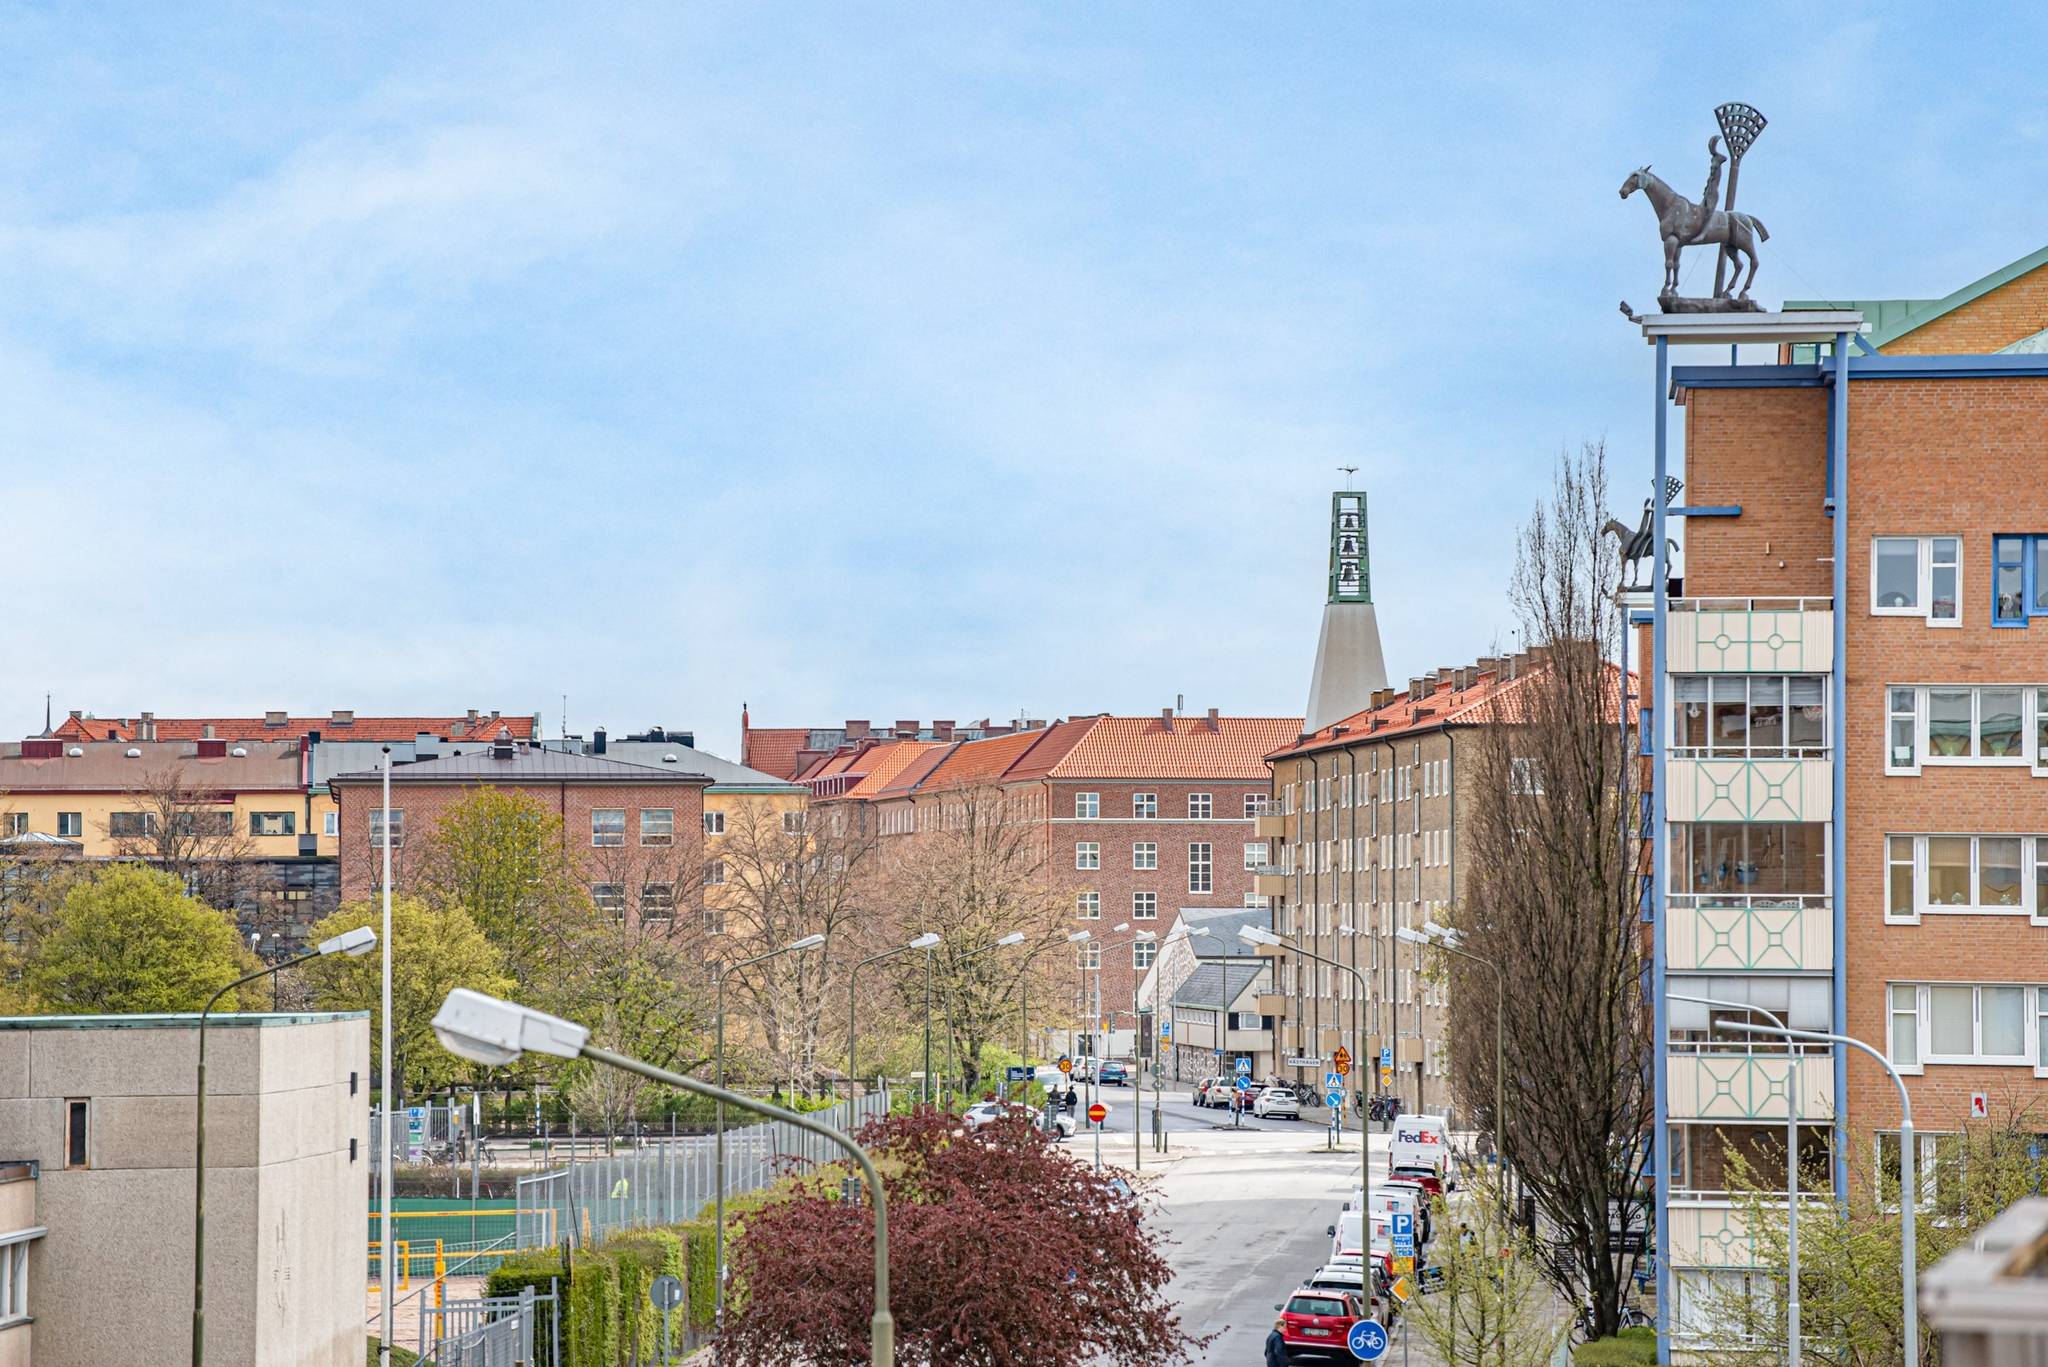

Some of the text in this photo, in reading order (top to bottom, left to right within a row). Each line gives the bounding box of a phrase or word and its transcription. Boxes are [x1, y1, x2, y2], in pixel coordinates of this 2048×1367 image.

[1337, 1065, 1347, 1073] 30
[1398, 1130, 1438, 1144] FedEx
[1397, 1215, 1409, 1233] P
